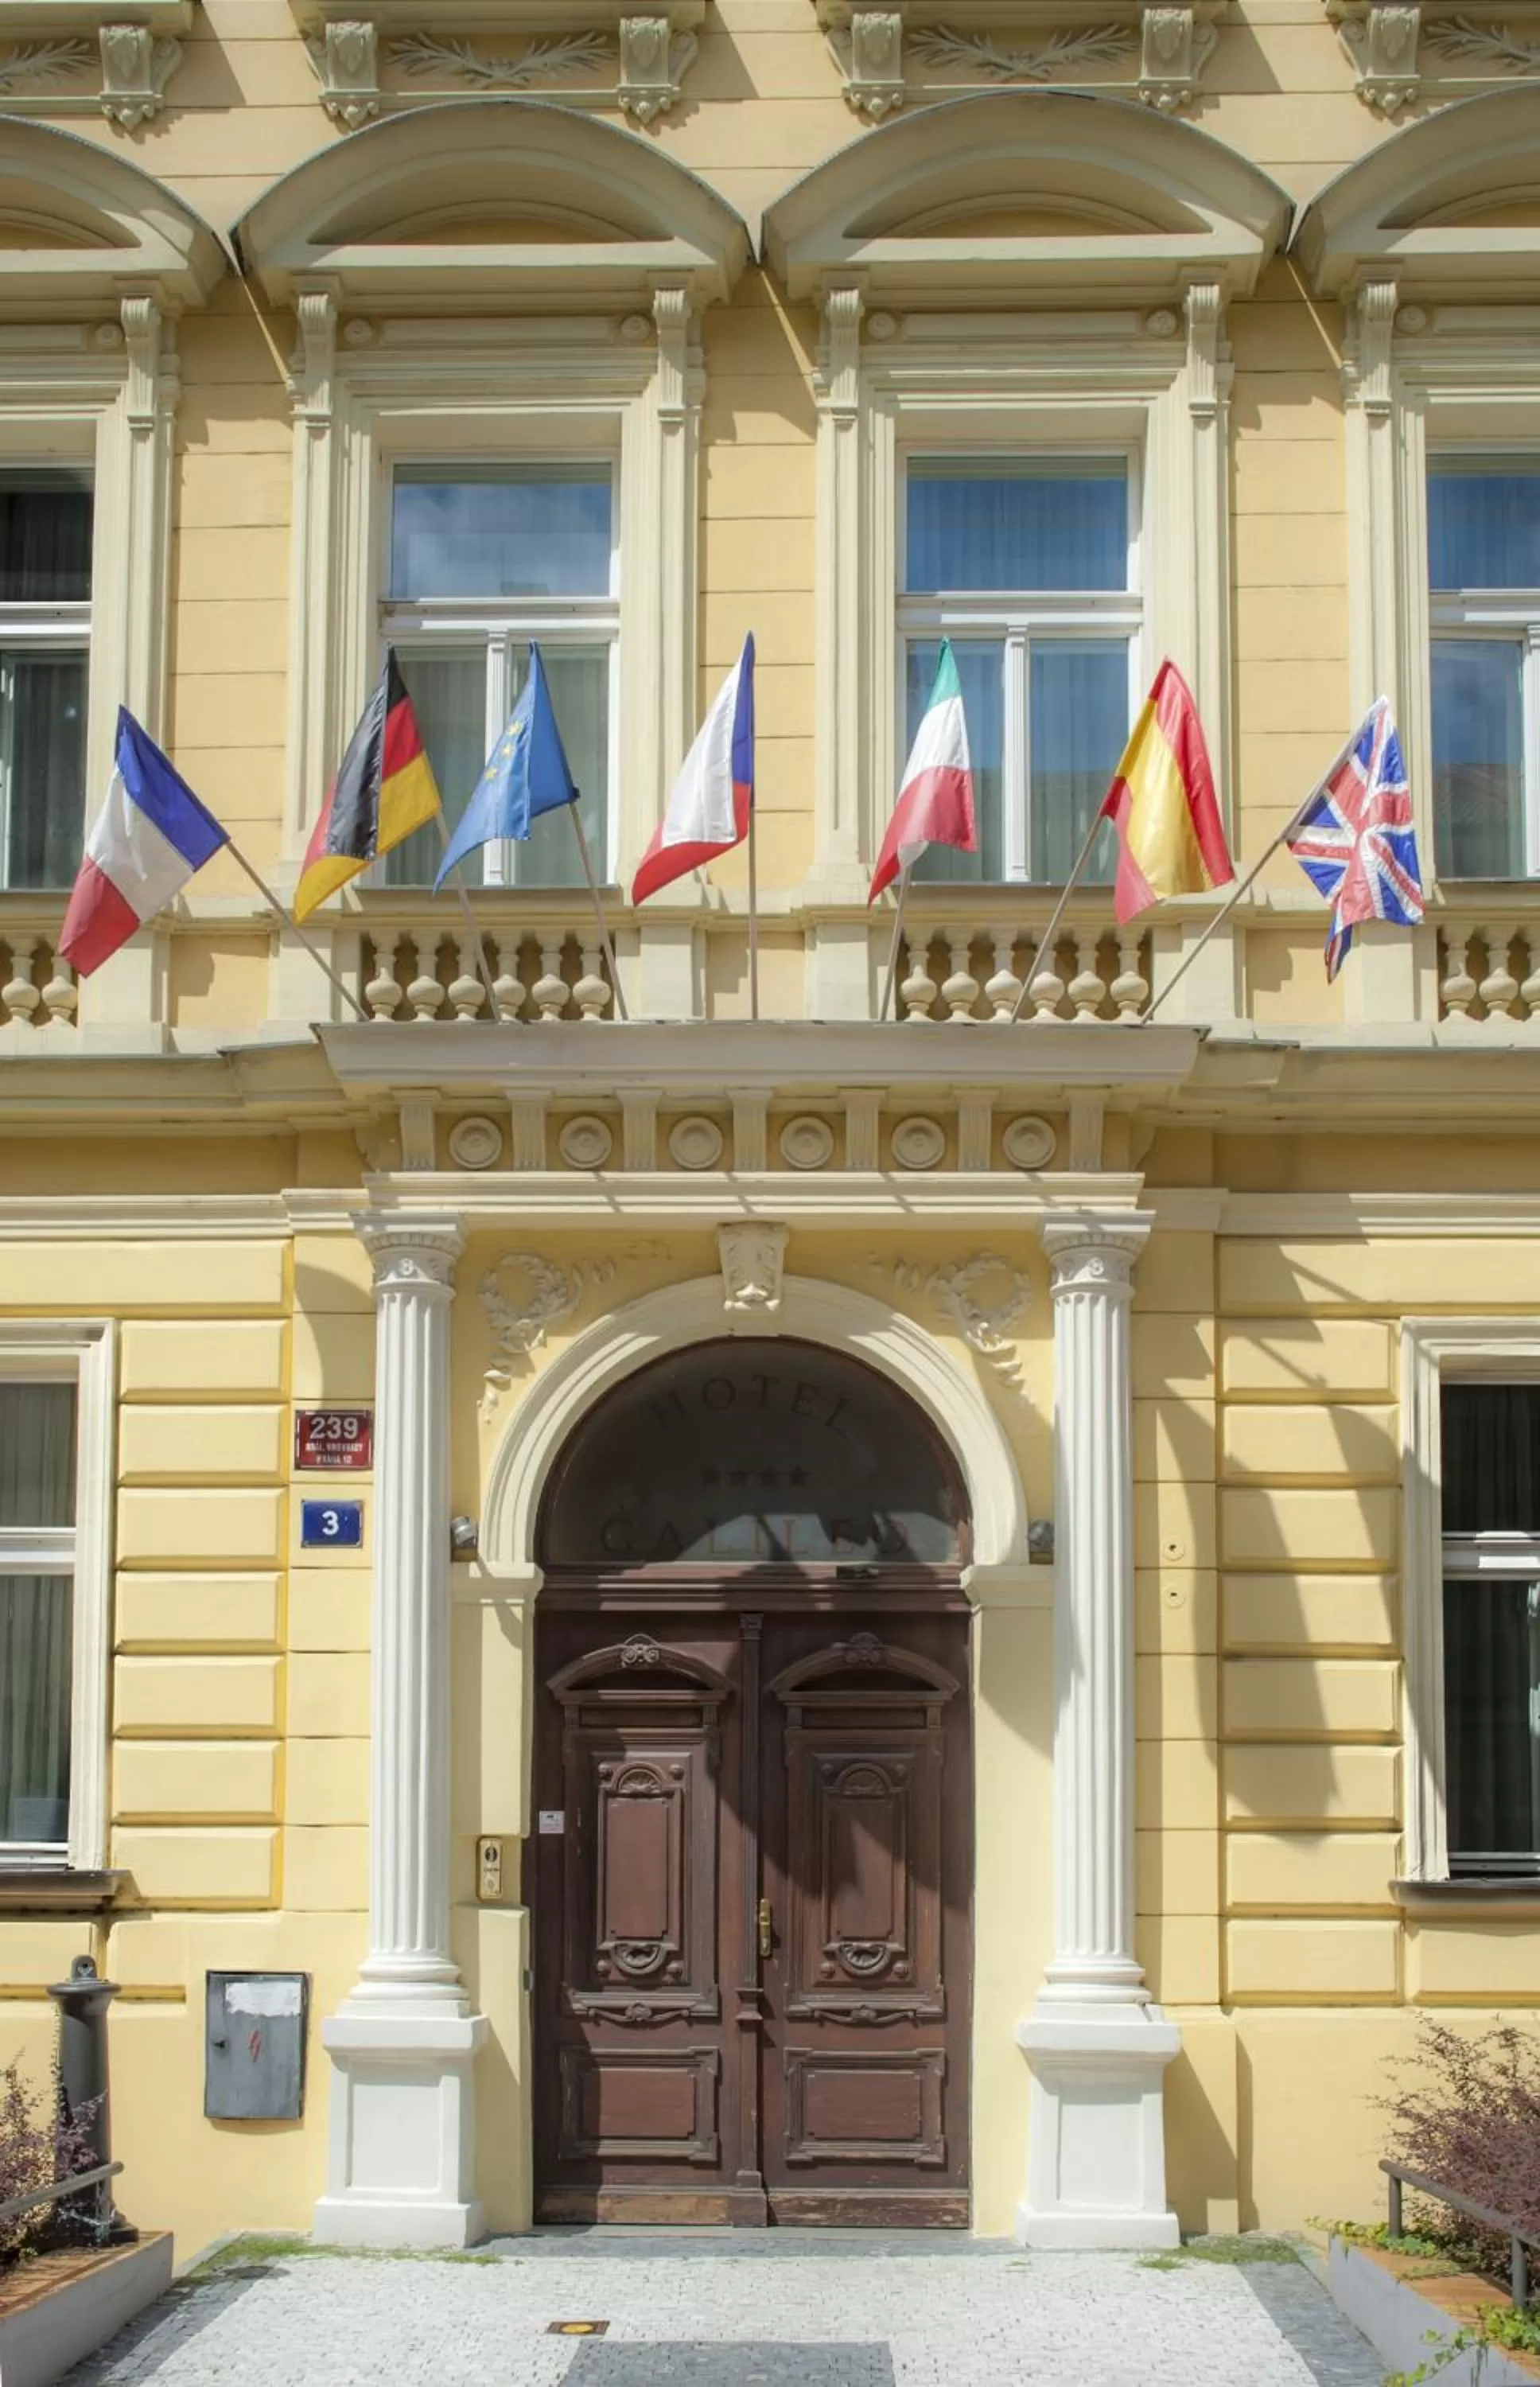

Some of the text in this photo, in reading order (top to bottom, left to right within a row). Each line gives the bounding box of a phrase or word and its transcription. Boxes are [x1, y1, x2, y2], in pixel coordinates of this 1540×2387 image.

[649, 1375, 853, 1437] HOTEL
[310, 1416, 358, 1439] 239
[322, 1510, 339, 1535] 3
[601, 1517, 908, 1554] GALILEO
